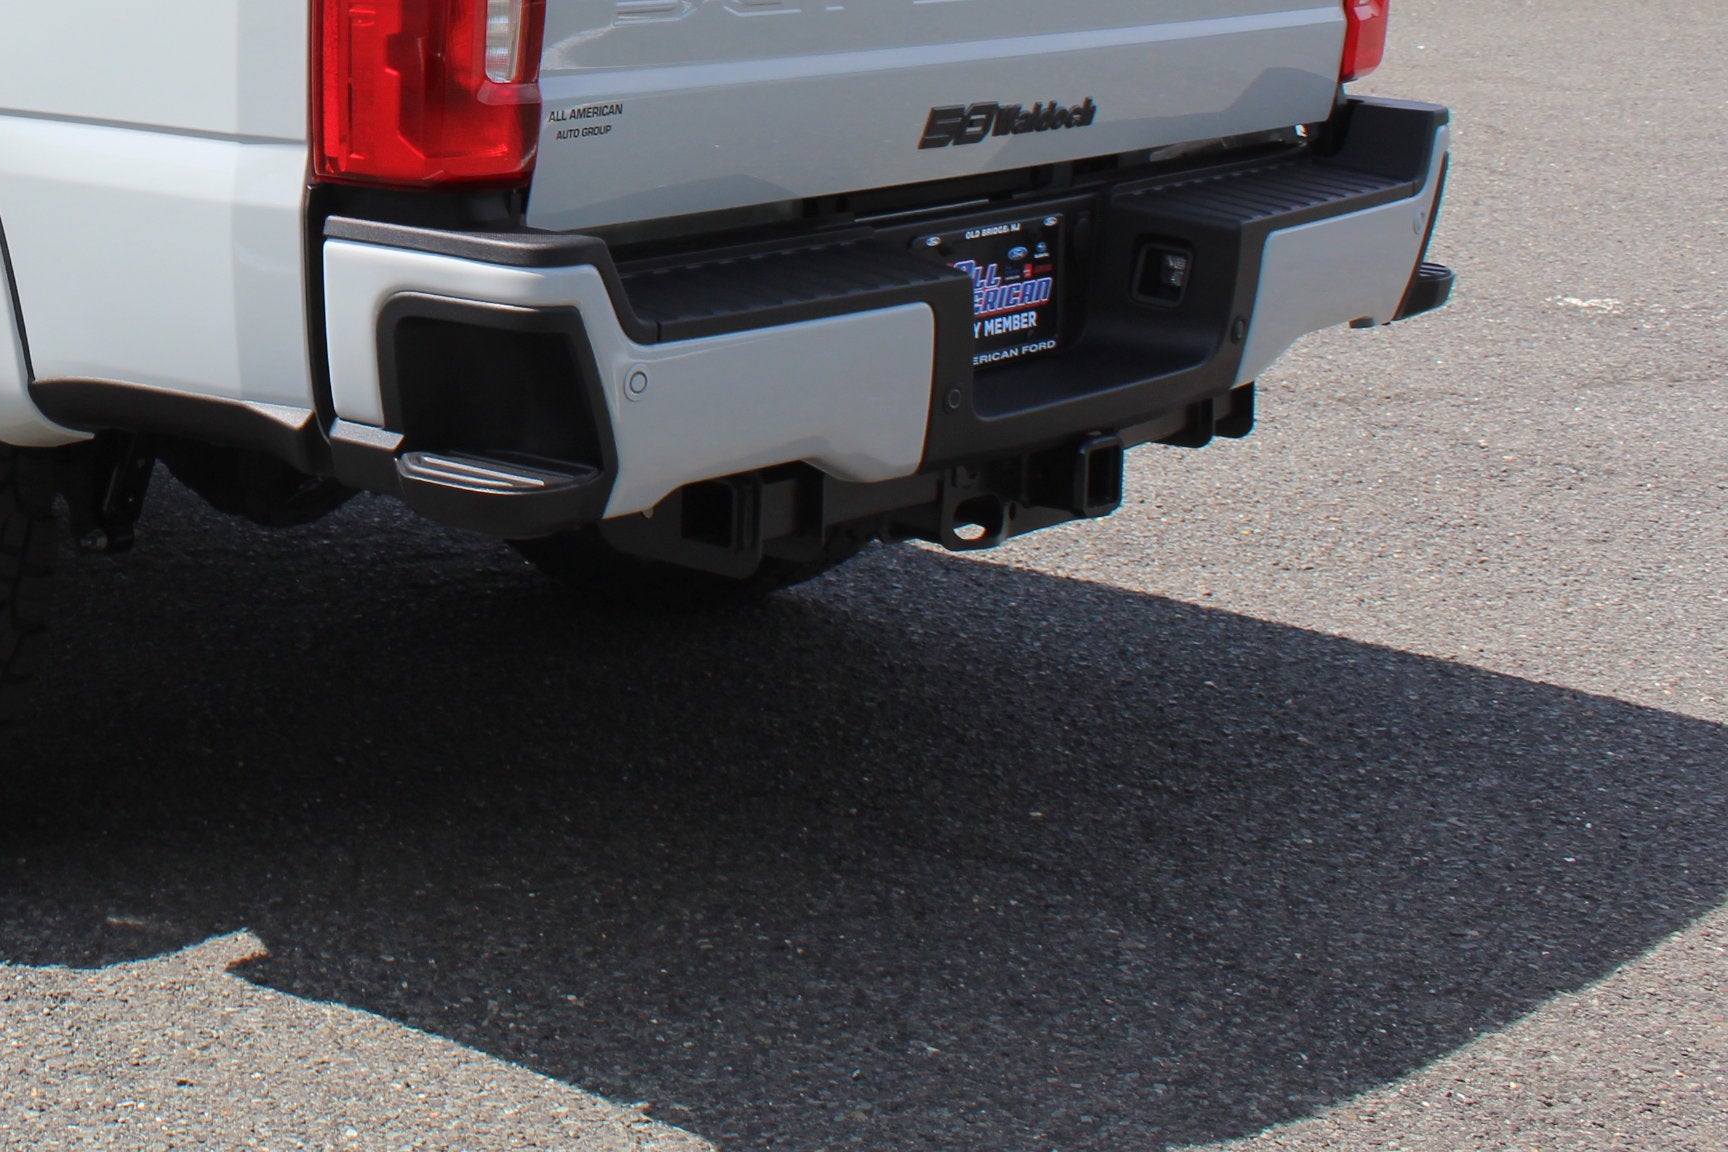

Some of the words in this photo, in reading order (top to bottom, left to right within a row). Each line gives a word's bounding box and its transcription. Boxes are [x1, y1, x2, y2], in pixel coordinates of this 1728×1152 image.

[549, 110, 566, 122] ALL
[569, 103, 623, 120] AMERICAN
[991, 96, 1097, 137] Waldoch
[556, 128, 580, 140] AUTO
[581, 124, 612, 137] GROUP
[965, 229, 980, 240] OLD
[1010, 222, 1021, 233] NJ
[973, 276, 1052, 315] ERICAN
[984, 311, 1037, 337] MEMBER
[973, 347, 1019, 366] ERICAN
[1021, 339, 1056, 356] FORD
